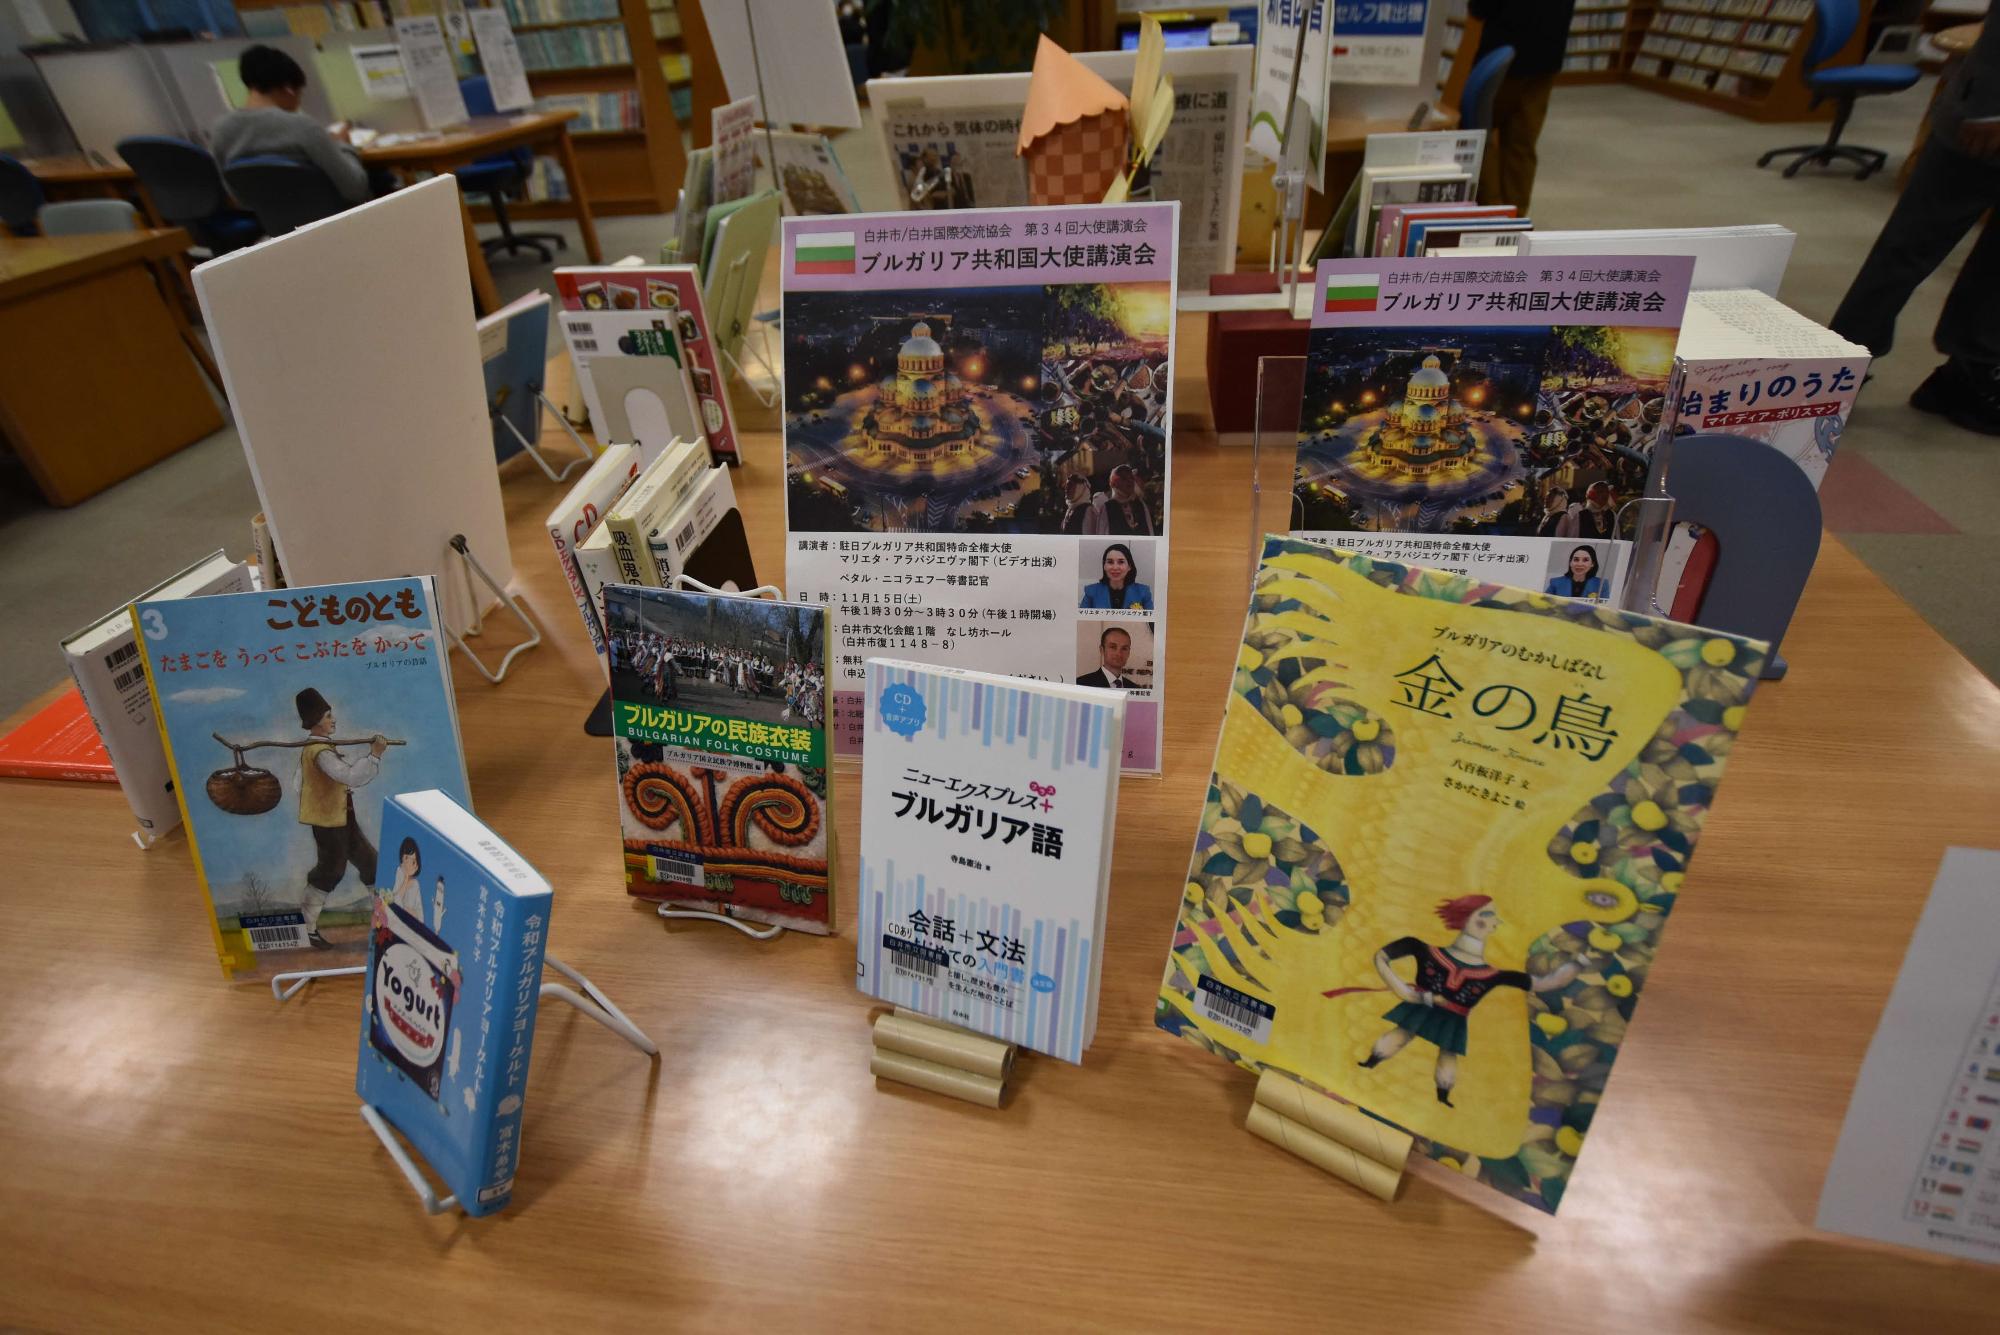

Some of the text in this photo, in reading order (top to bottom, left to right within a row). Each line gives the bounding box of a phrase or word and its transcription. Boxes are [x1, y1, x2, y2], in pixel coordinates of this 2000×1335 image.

[861, 242, 1157, 274] ブルガリア共和国大使講演会
[1383, 291, 1666, 313] ブルガリア共和国大使講演会
[1680, 366, 1857, 417] 始まりのうた
[1706, 403, 1839, 428] マイ・ディア・ポリスマン
[142, 609, 168, 641] 3
[267, 587, 423, 631] こどものとも
[160, 633, 426, 672] たまごを うって こぶたを かって
[1433, 626, 1608, 681] ブルガリアのむかしばなし
[894, 693, 911, 705] CD
[1390, 654, 1619, 762] 金の鳥
[623, 705, 812, 752] ブルガリアの民族衣装
[628, 727, 809, 763] BULGARIAN FOLK COSTUME
[891, 790, 1064, 860] ブルガリア語
[888, 922, 913, 939] CDあり
[381, 960, 441, 1031] Yogurt
[474, 900, 505, 1094] 令和ブルガリアヨーグルト
[507, 914, 543, 1087] 令和ブルガリアヨーグルト
